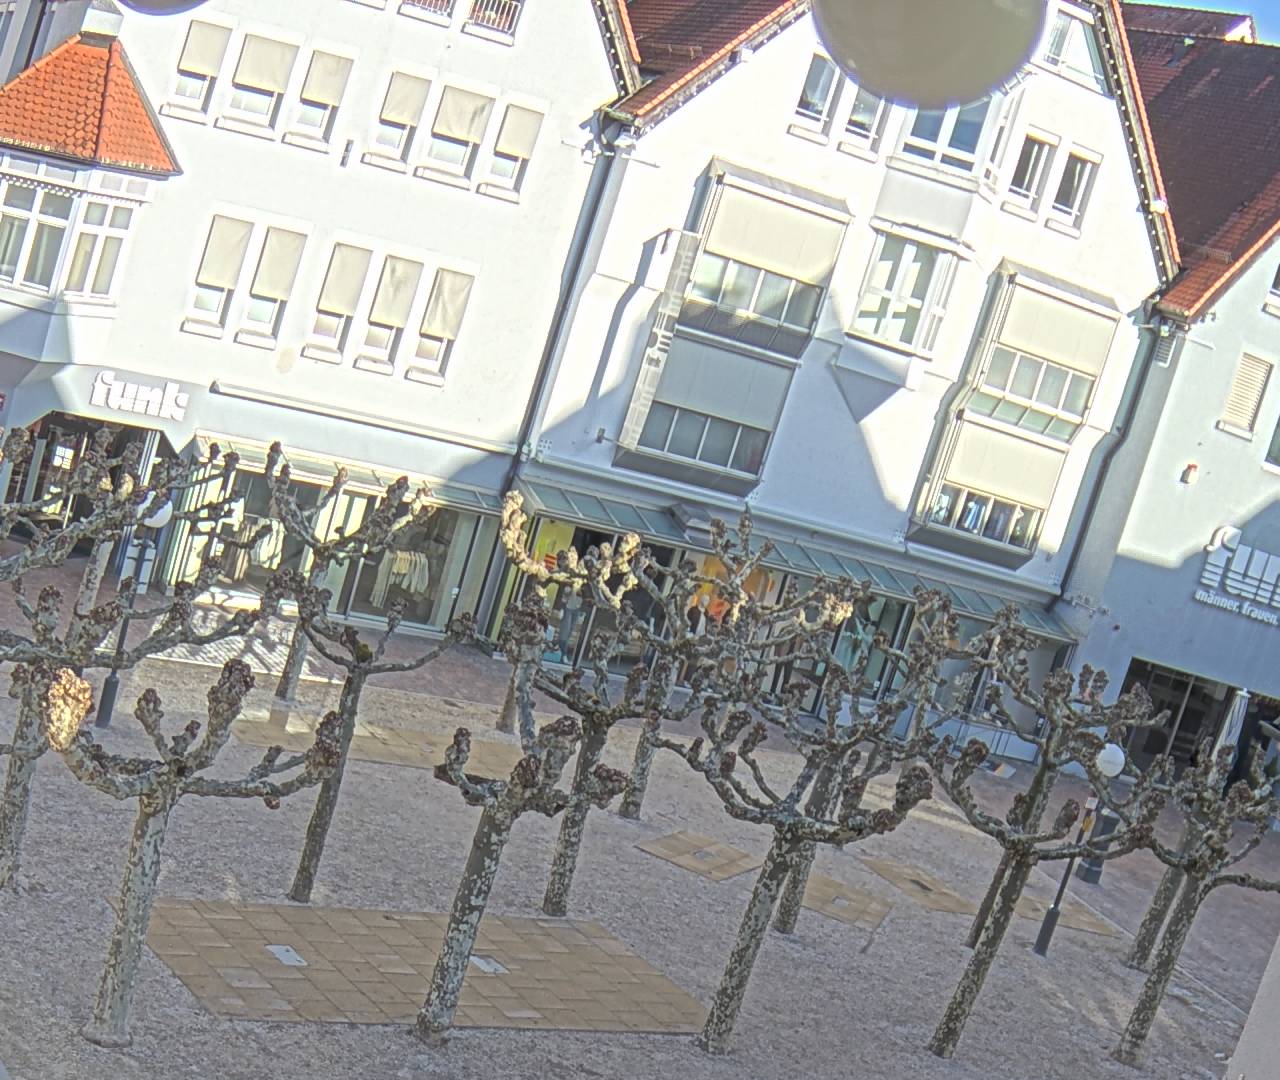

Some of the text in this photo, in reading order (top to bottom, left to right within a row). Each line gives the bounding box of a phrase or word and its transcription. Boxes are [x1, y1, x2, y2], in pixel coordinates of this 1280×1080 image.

[89, 370, 190, 422] funk
[1194, 588, 1240, 612] männer.
[1241, 602, 1279, 626] frauen.
